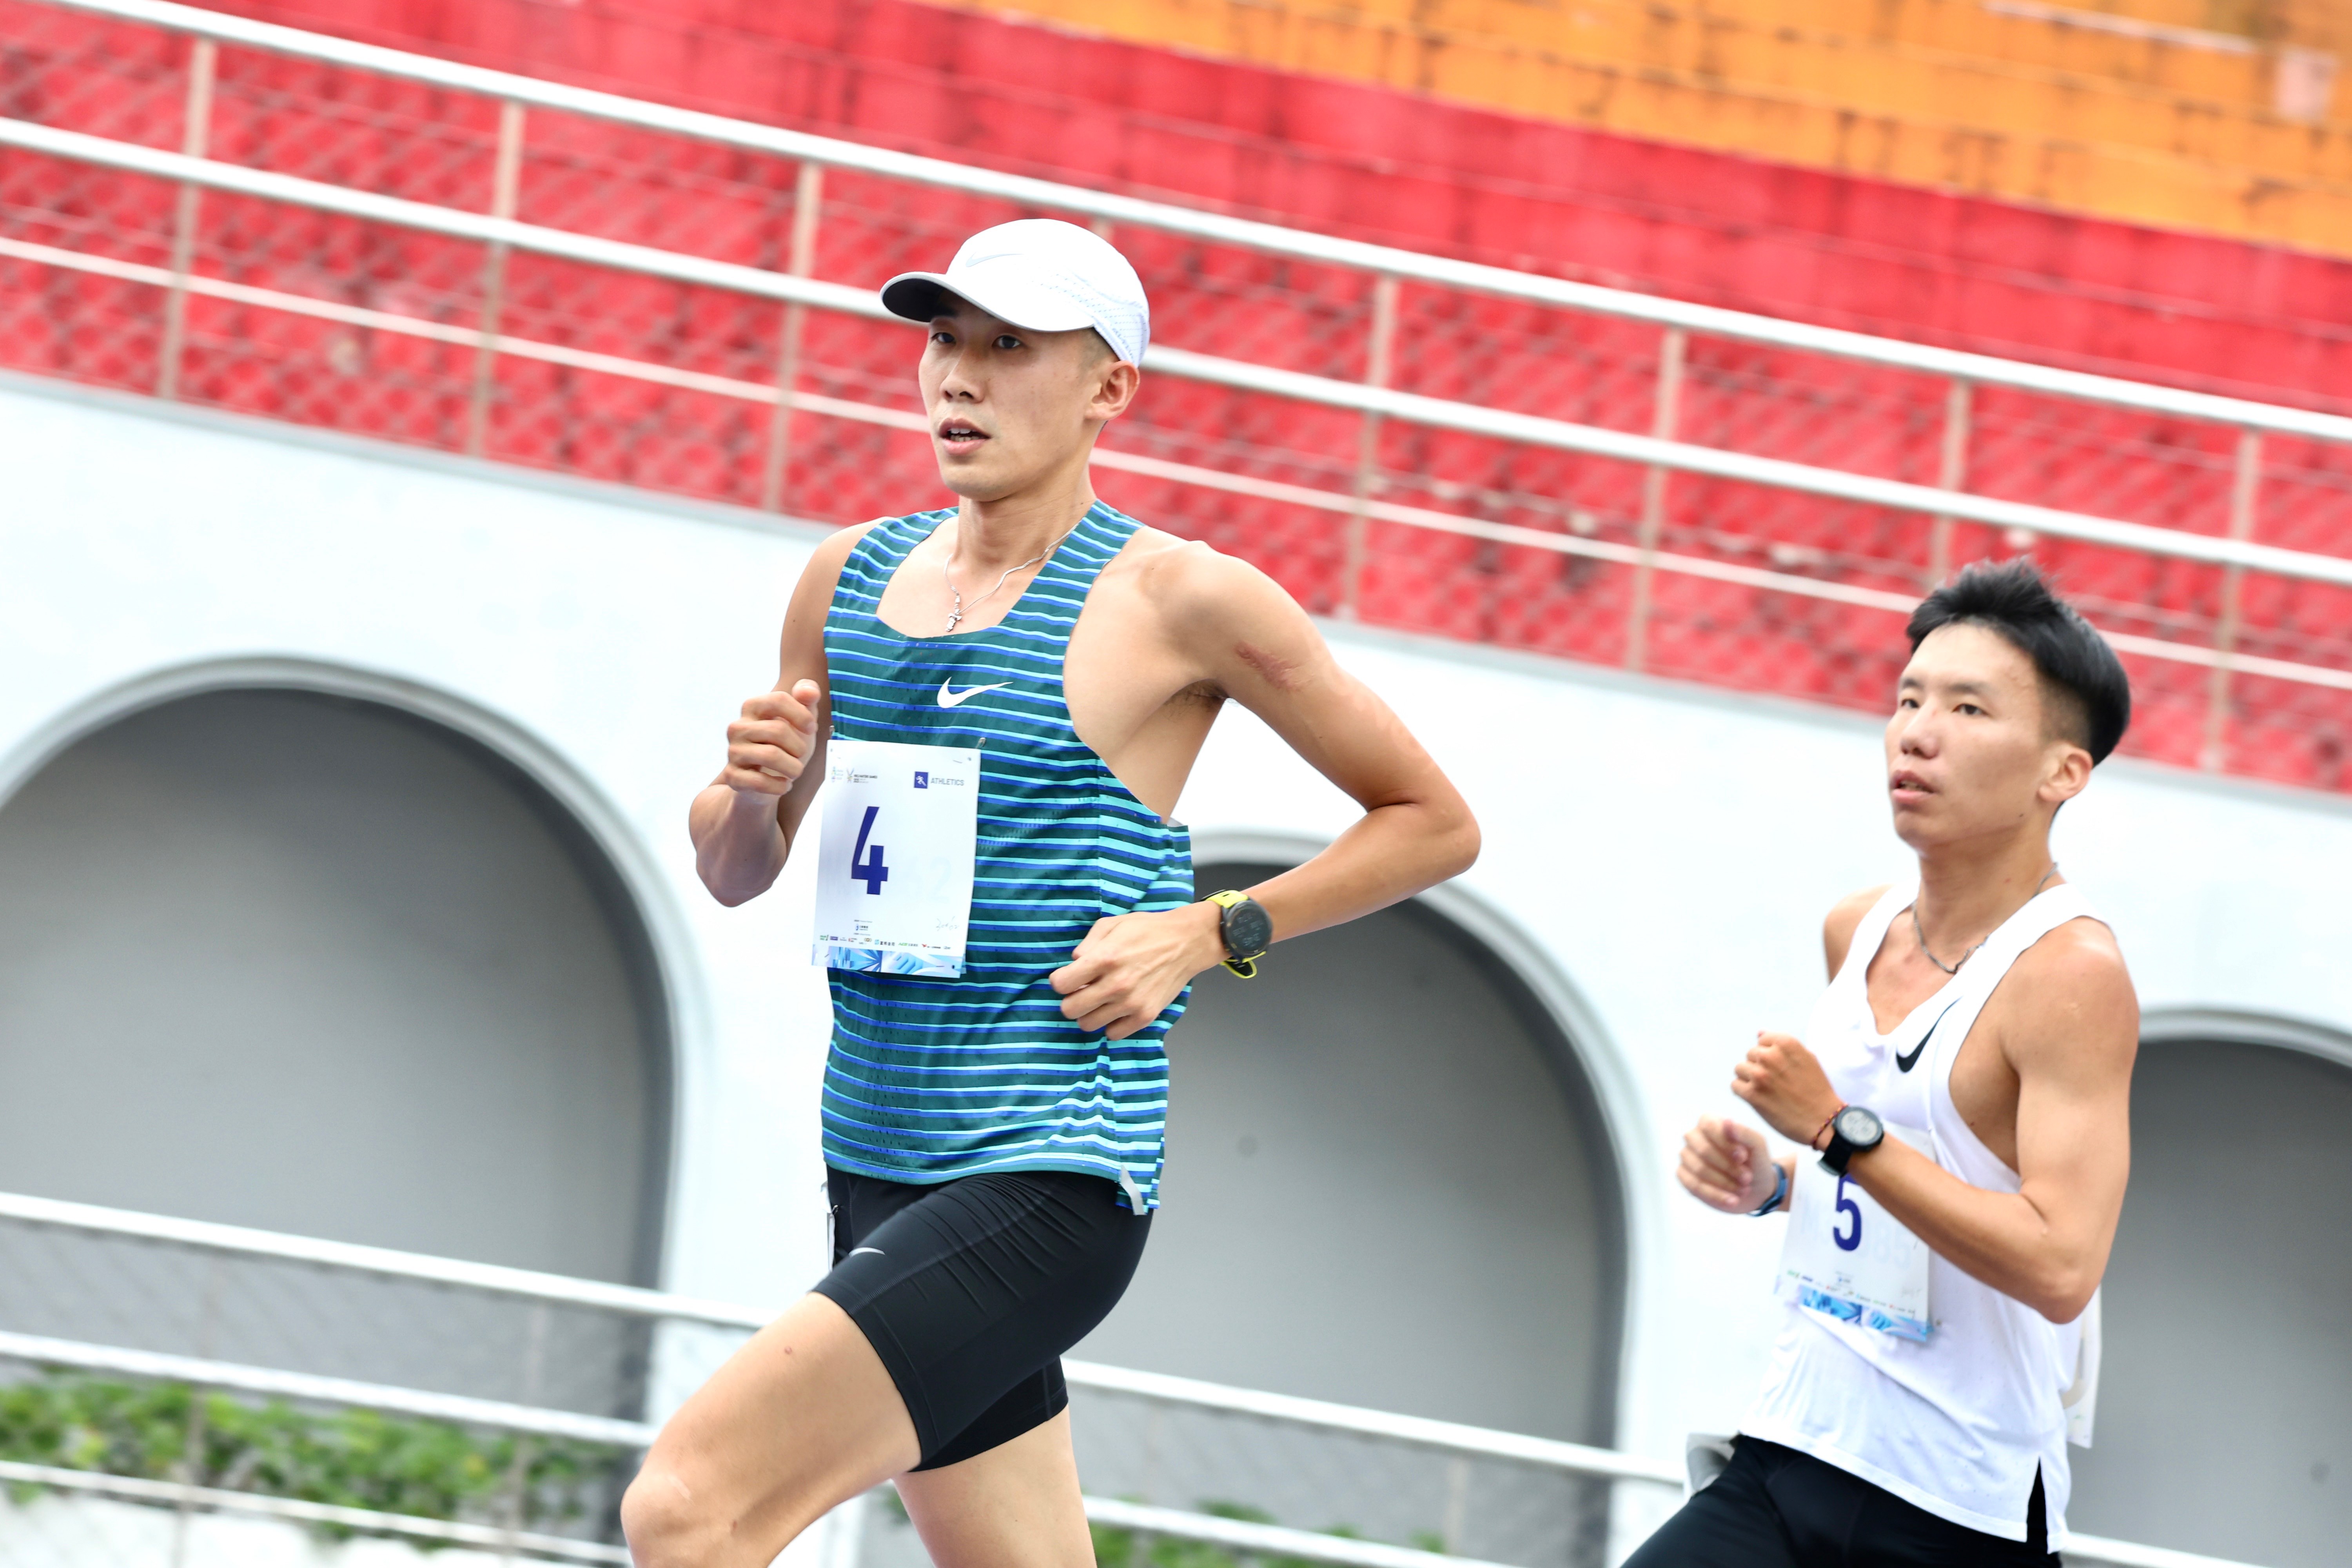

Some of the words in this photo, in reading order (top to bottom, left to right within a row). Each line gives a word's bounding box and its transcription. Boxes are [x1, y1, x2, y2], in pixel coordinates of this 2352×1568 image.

[931, 777, 965, 786] ATHLETICS
[851, 806, 889, 895] 4
[1833, 1172, 1862, 1251] 5
